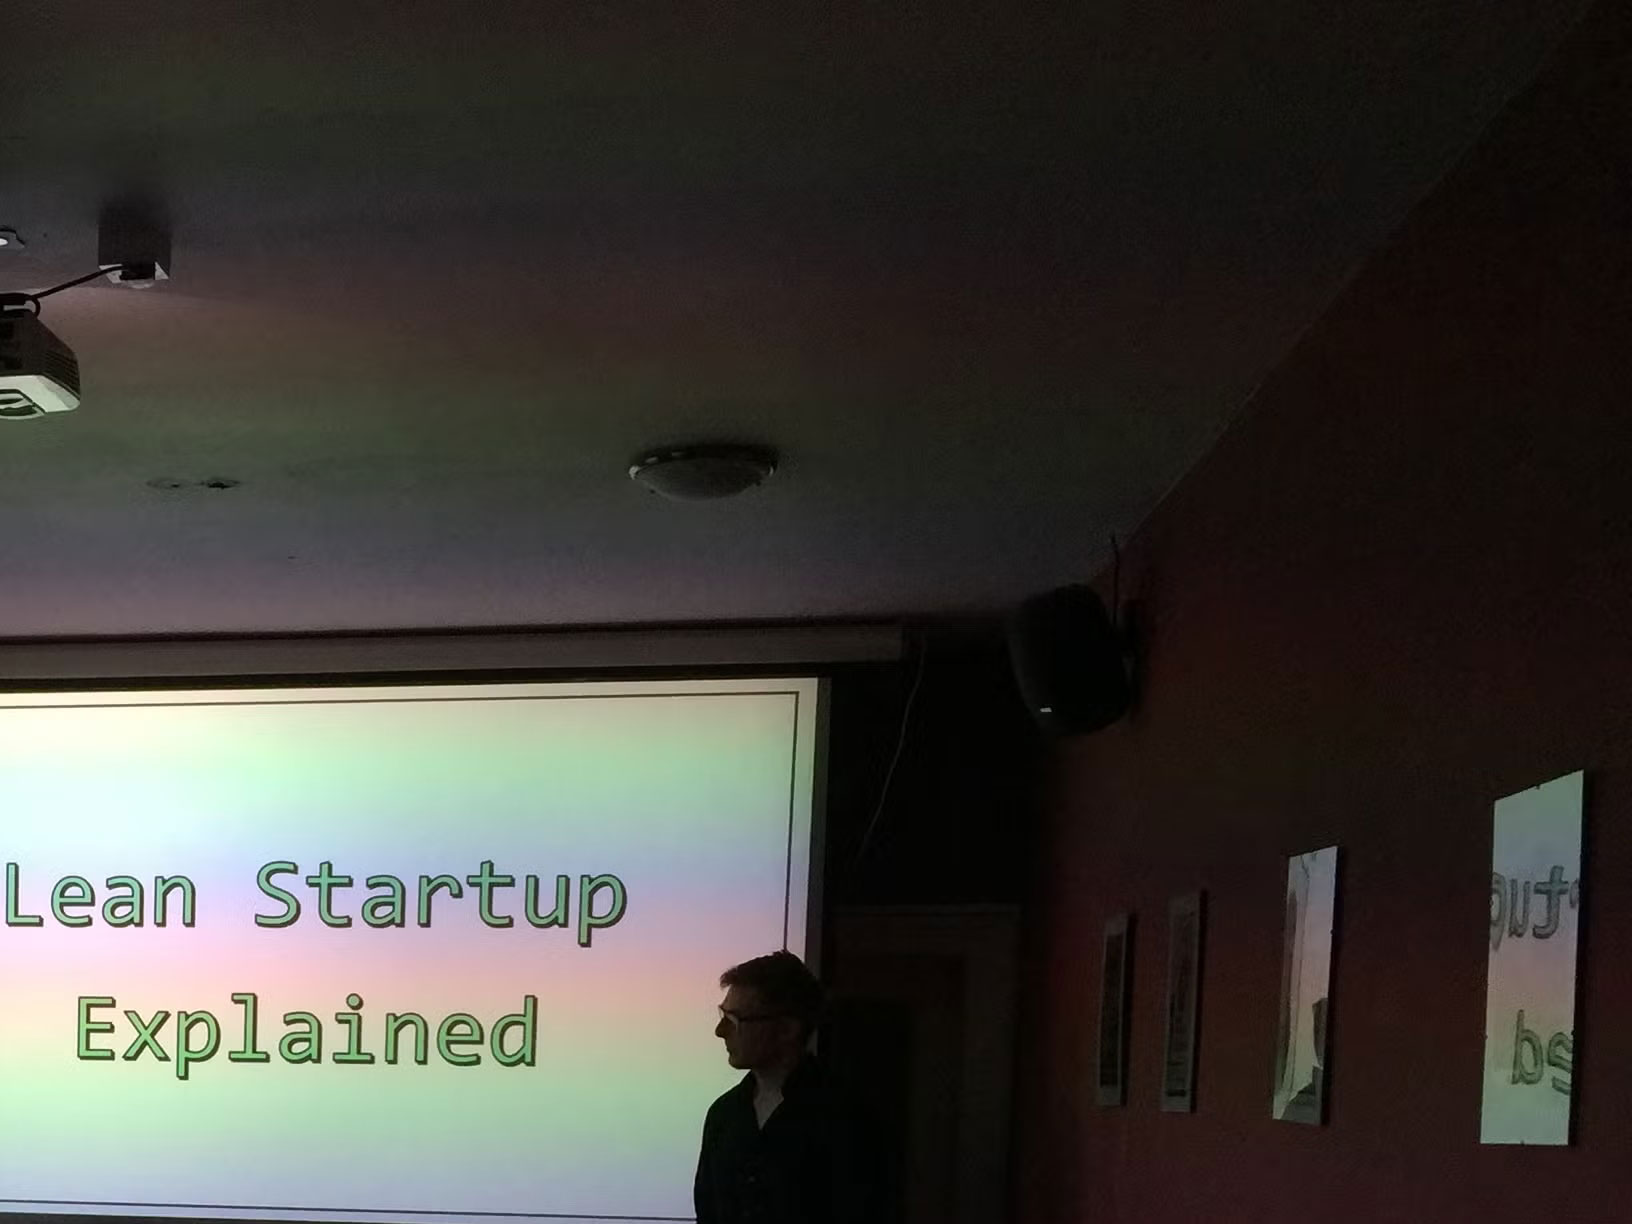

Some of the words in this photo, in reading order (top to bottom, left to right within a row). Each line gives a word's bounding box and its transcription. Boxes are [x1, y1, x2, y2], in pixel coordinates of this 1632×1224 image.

[5, 862, 196, 928] Lean
[254, 859, 628, 947] Startup
[77, 992, 539, 1080] Explained
